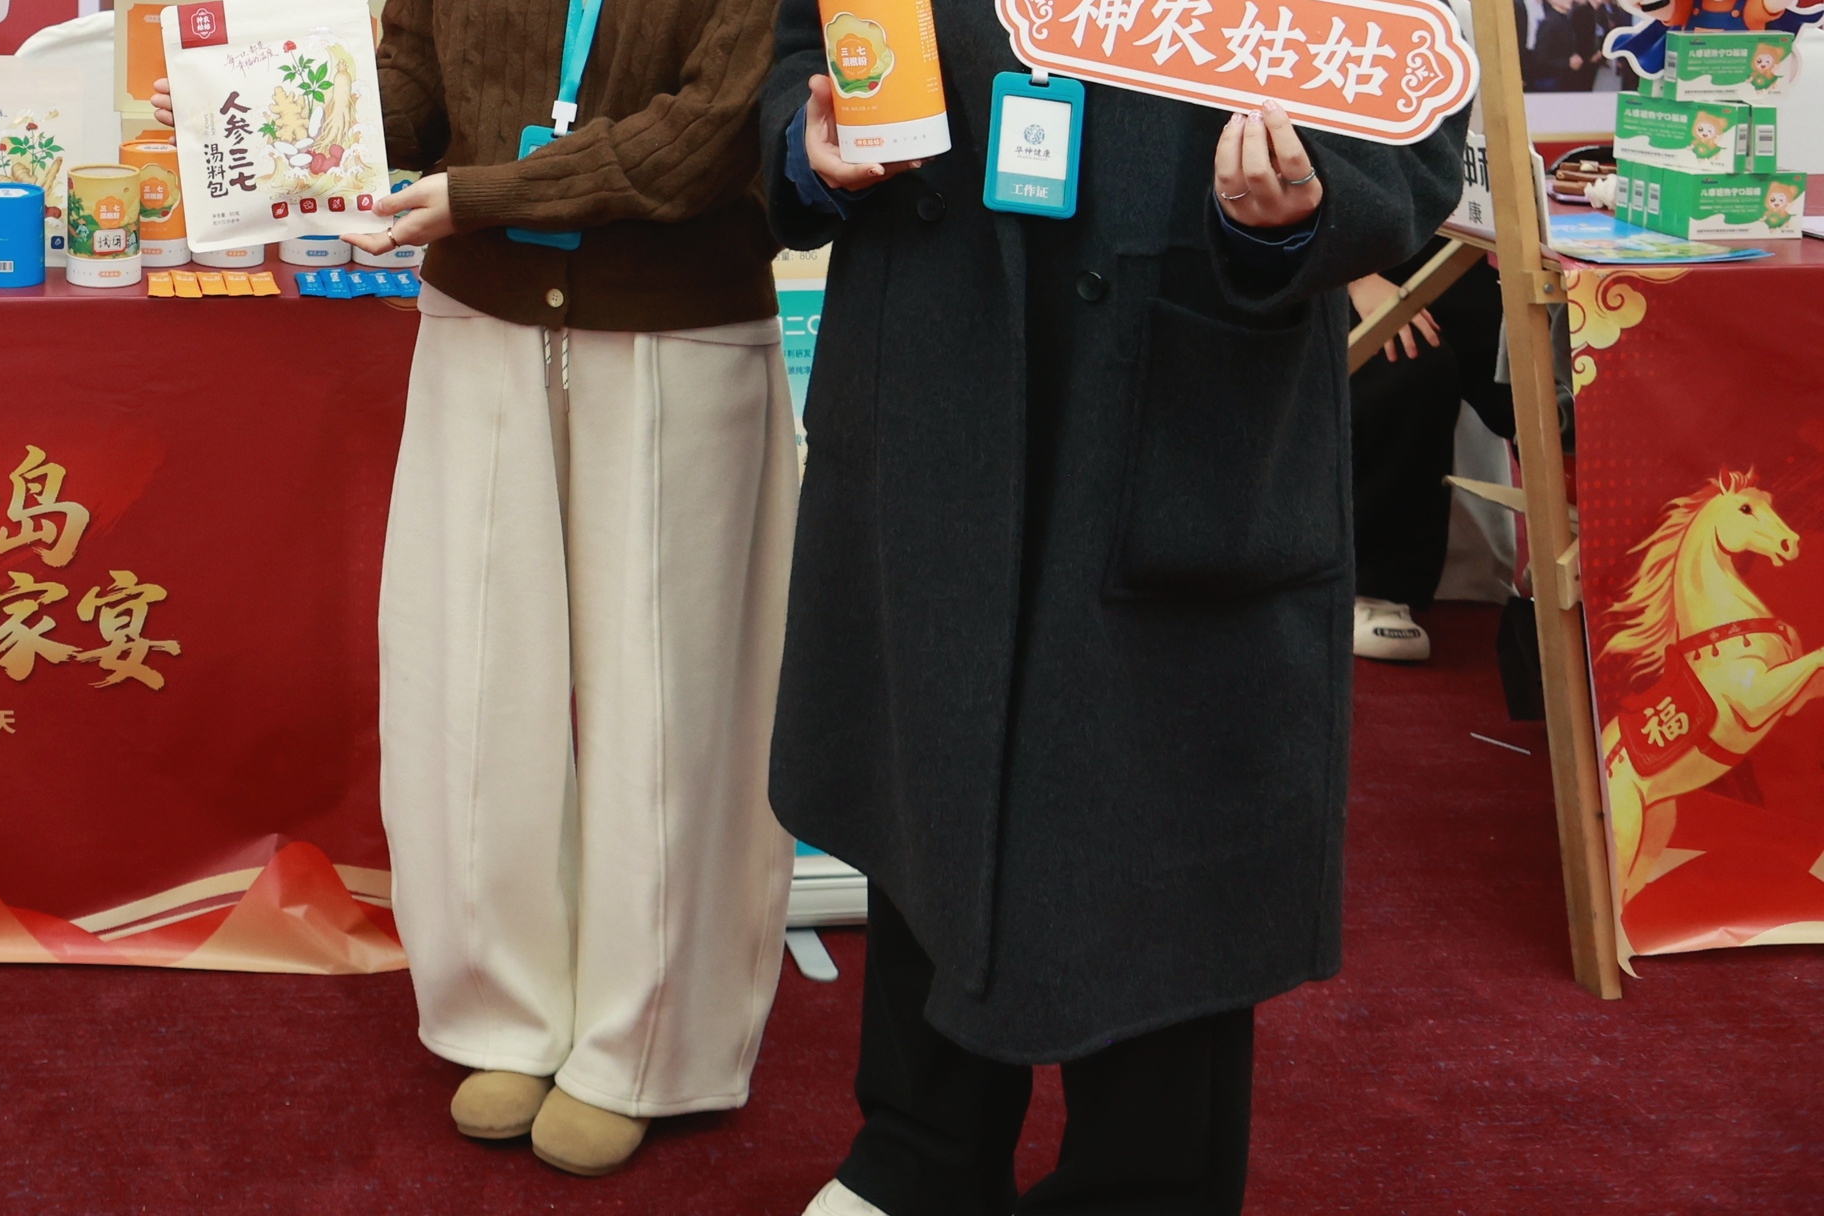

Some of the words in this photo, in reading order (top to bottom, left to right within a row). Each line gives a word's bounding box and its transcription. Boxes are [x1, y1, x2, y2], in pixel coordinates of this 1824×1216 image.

[220, 90, 258, 193] 人参三七
[1010, 183, 1050, 200] 工作证
[783, 349, 812, 358] 利研发
[1640, 696, 1690, 747] 福
